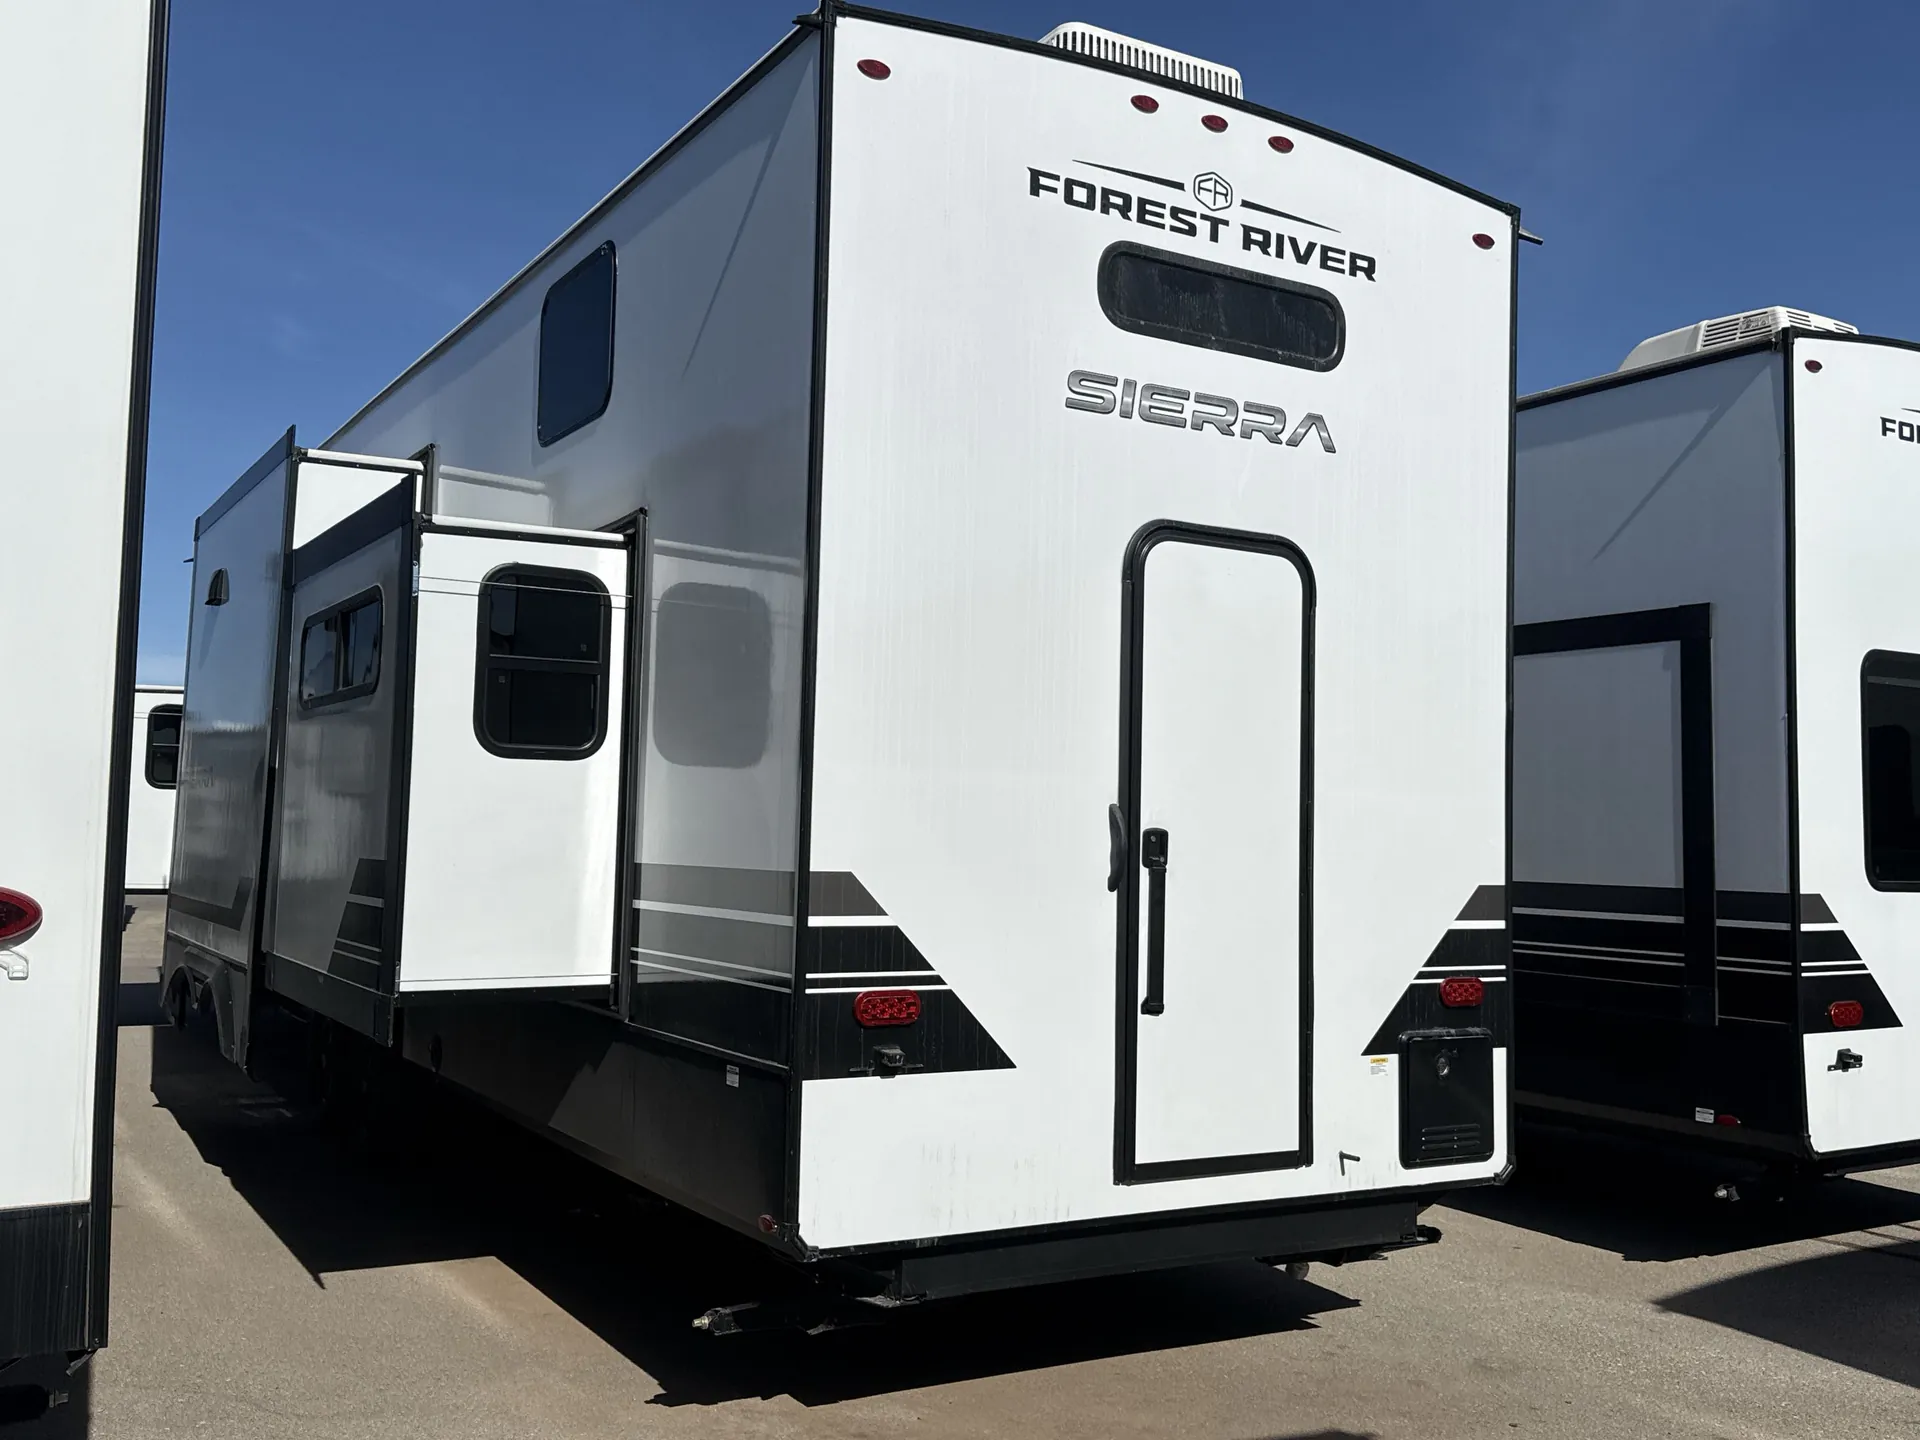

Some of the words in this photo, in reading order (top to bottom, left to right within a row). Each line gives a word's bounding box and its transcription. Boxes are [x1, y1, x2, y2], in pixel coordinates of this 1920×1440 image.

[1026, 166, 1230, 244] FOREST
[1240, 223, 1376, 283] RIVER
[1064, 369, 1337, 455] SIERRA
[1879, 416, 1920, 444] FO
